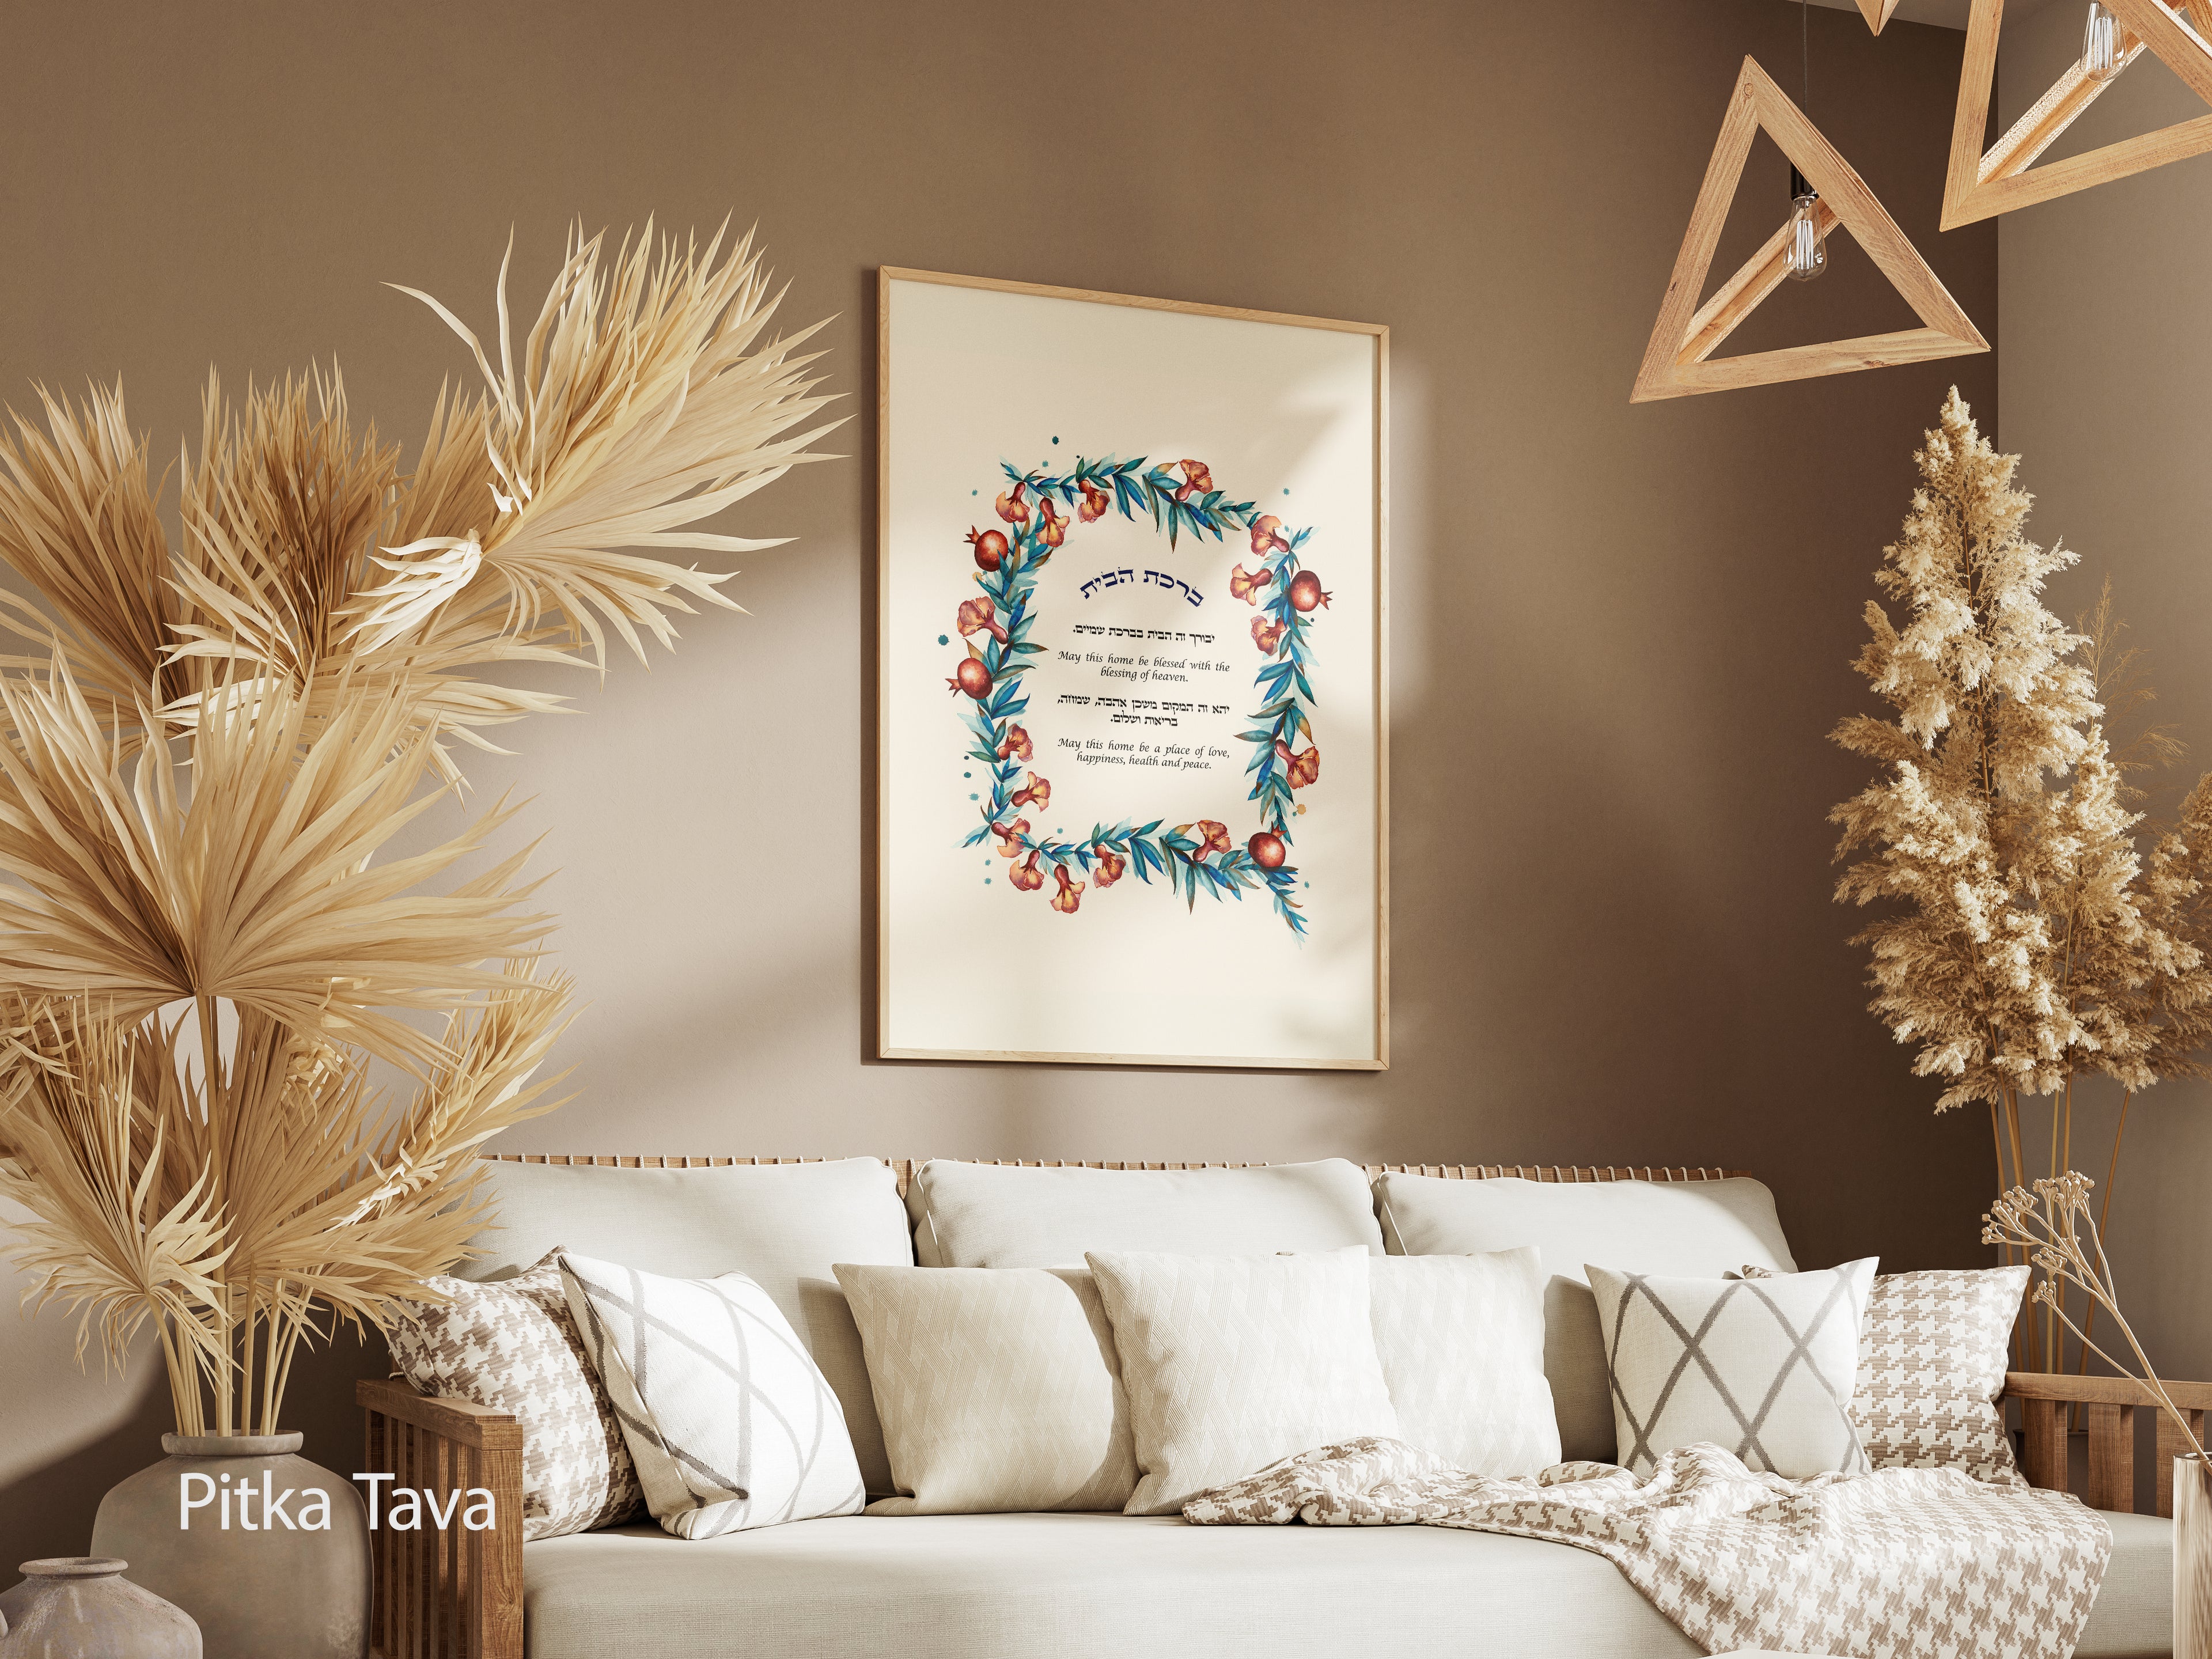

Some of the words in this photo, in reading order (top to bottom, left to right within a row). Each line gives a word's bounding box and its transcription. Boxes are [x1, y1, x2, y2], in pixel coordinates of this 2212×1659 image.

[1080, 567, 1134, 599] הבית
[1143, 570, 1204, 607] ברכת
[1073, 624, 1105, 635] שמיים.
[1108, 627, 1143, 638] בברכת
[1147, 630, 1172, 640] הבית
[1176, 632, 1185, 641] זה
[1189, 634, 1215, 647] יבורך
[1058, 651, 1081, 664] May
[1086, 653, 1103, 662] this
[1108, 654, 1134, 665] home
[1139, 656, 1149, 666] be
[1154, 657, 1187, 668] blessed
[1190, 660, 1211, 671] with
[1215, 662, 1230, 672] the
[1101, 666, 1137, 681] blessing
[1141, 669, 1150, 682] of
[1153, 671, 1188, 682] heaven.
[1095, 697, 1127, 707] אהבה,
[1132, 699, 1157, 712] משכן
[1162, 701, 1193, 715] המקום
[1198, 704, 1208, 713] זה
[1213, 704, 1230, 714] יהא
[1111, 710, 1141, 724] ושלום.
[1145, 715, 1177, 726] בריאות
[1058, 738, 1081, 751] May
[1086, 739, 1103, 749] this
[1108, 740, 1134, 751] home
[1139, 742, 1149, 752] be
[1165, 744, 1190, 756] place
[1195, 745, 1205, 758] of
[1209, 747, 1230, 759] love,
[1077, 752, 1126, 766] happiness,
[1129, 755, 1159, 766] health
[1162, 756, 1180, 767] and
[1181, 760, 1211, 771] peace.
